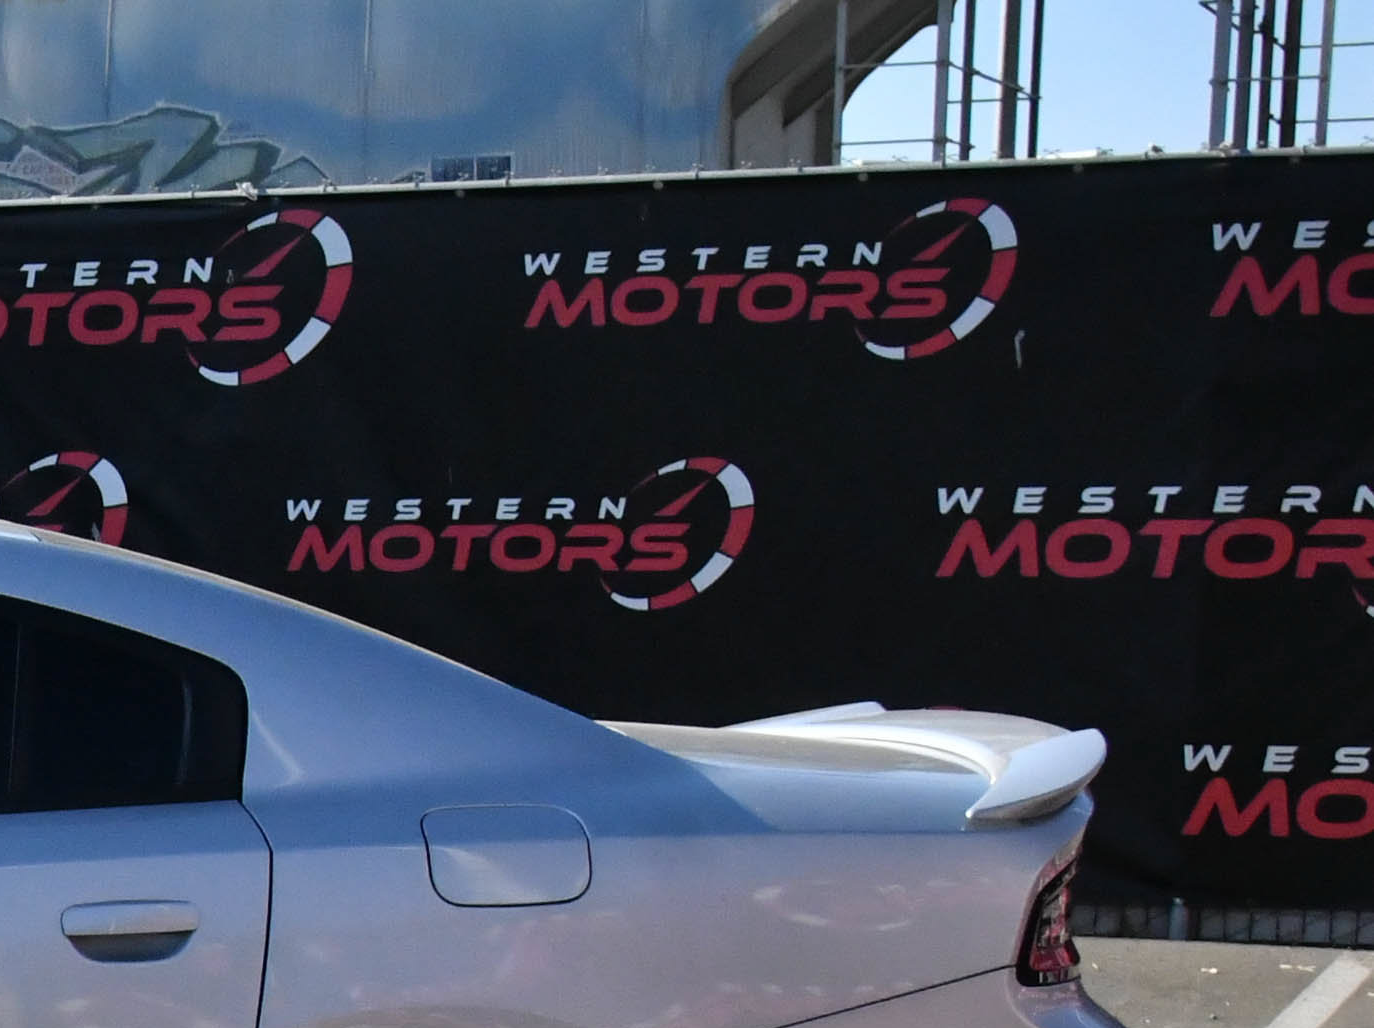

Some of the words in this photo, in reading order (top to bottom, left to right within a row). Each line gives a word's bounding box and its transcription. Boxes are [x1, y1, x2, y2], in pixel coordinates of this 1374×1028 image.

[523, 241, 883, 276] WESTERN
[524, 267, 951, 329] MOTORS
[286, 497, 626, 521] WESTERN
[287, 522, 691, 574] MOTORS
